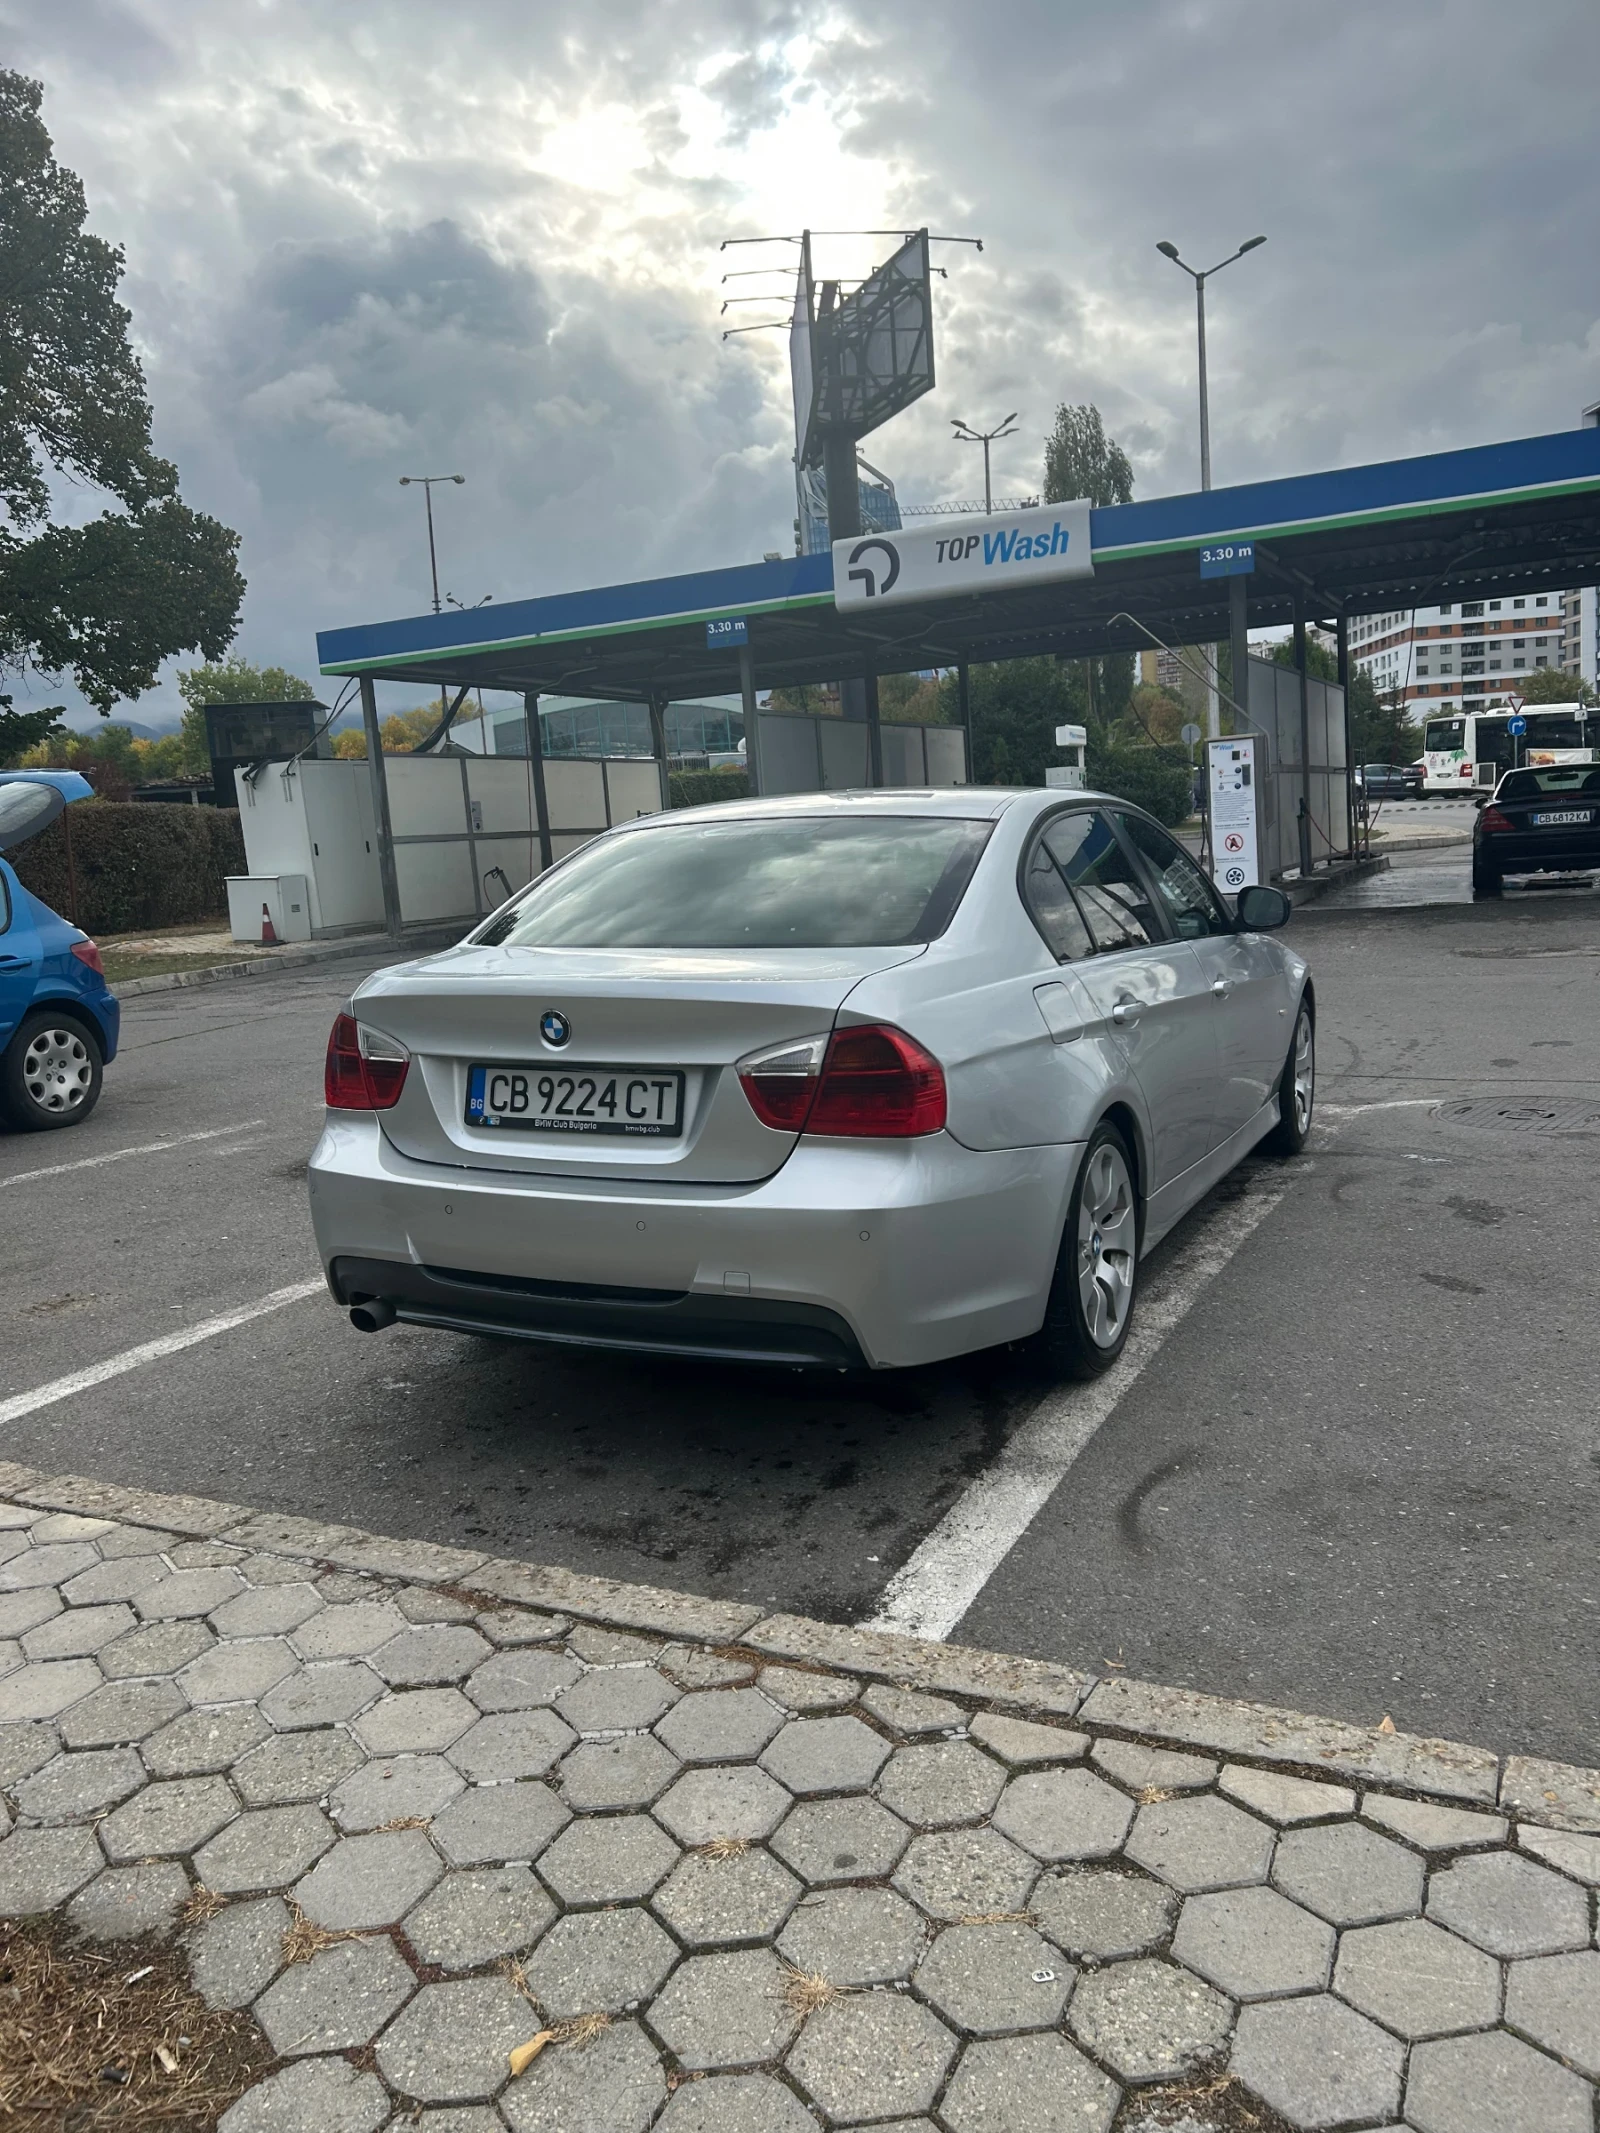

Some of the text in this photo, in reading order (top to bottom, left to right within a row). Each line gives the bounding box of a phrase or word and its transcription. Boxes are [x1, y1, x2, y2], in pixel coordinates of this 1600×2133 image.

[935, 522, 1069, 566] TOP Wash
[1202, 546, 1252, 563] 3.30 m
[708, 621, 745, 634] 3.30 m
[470, 1098, 483, 1110] BG
[489, 1074, 673, 1120] CB 9224 CT
[553, 1119, 568, 1129] Club
